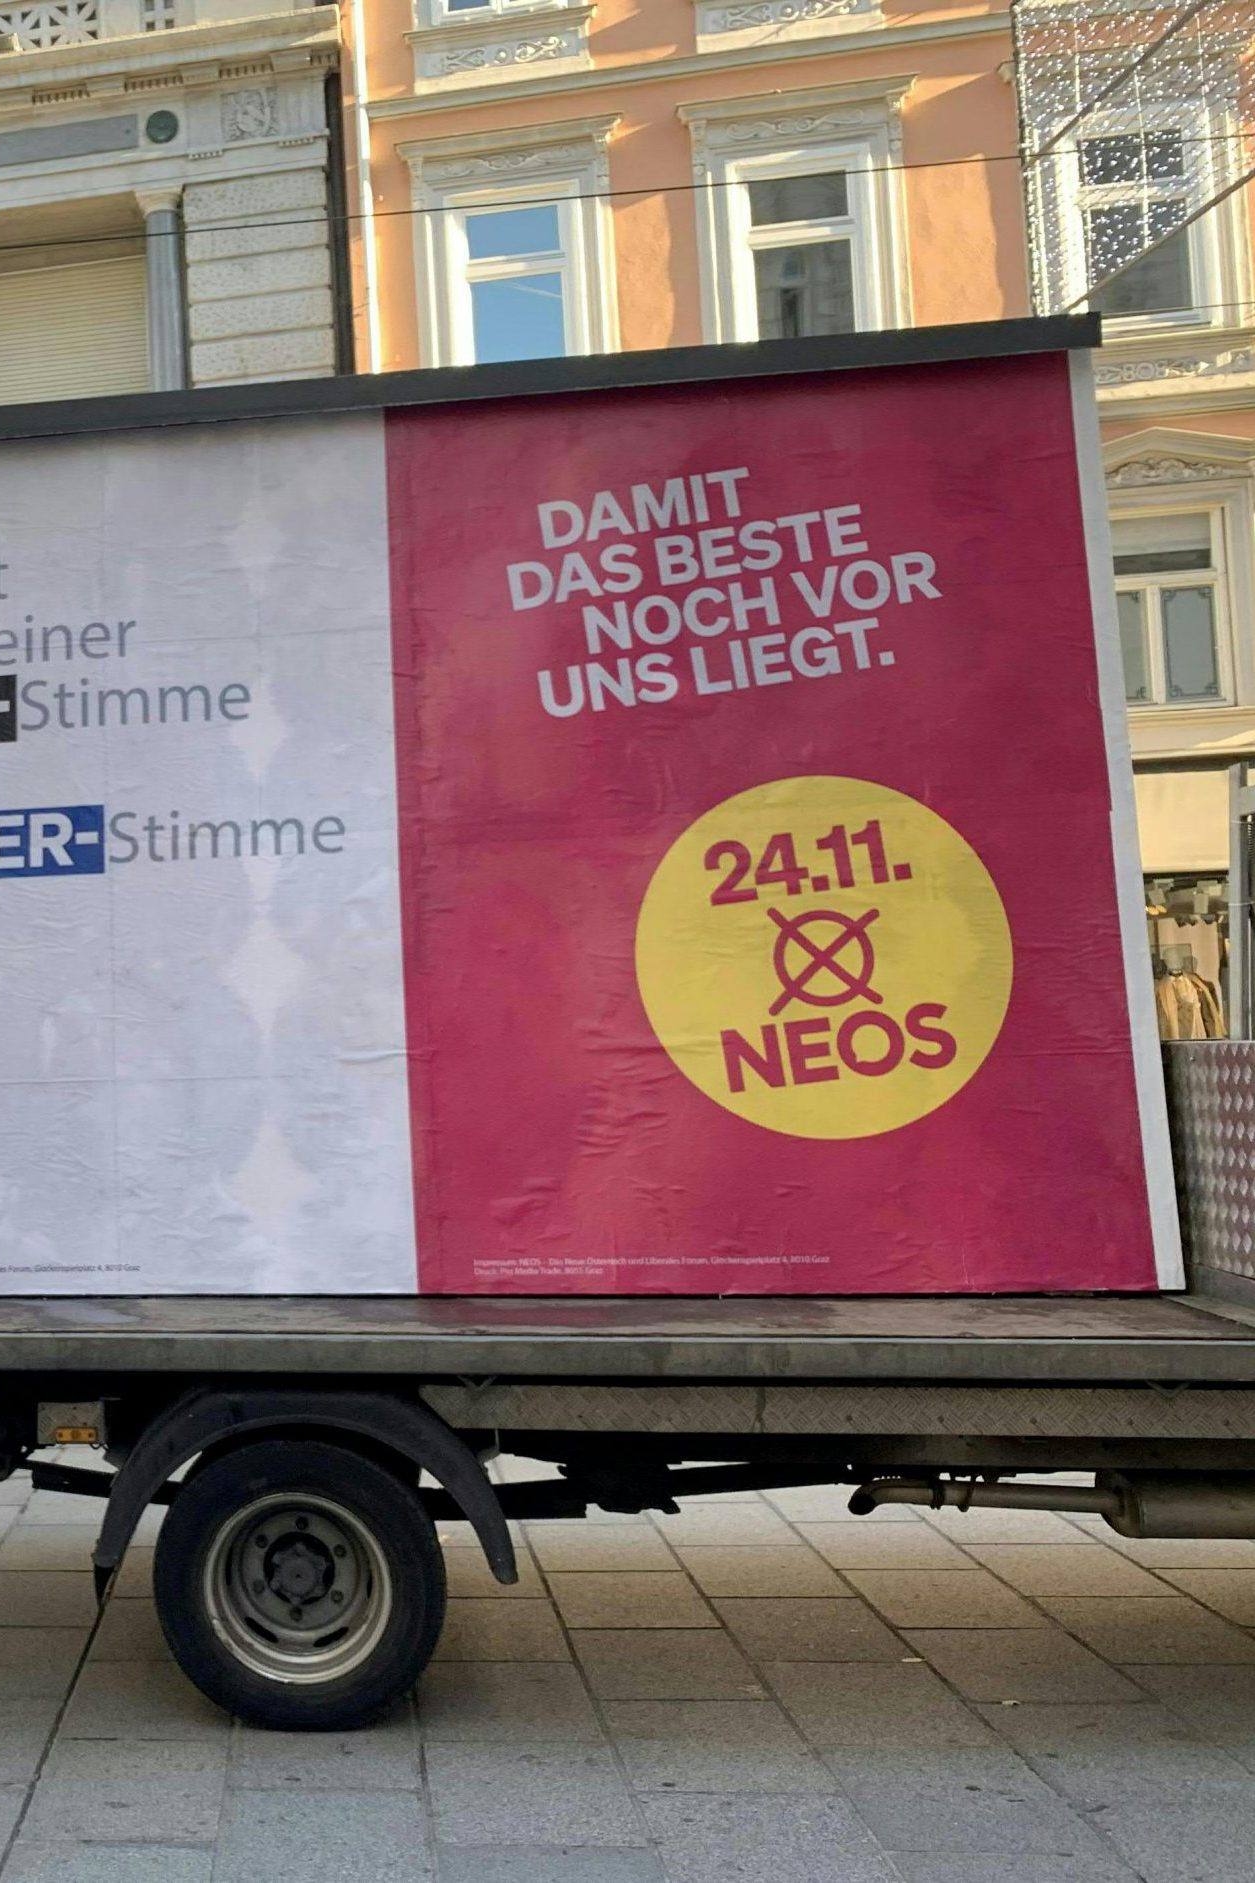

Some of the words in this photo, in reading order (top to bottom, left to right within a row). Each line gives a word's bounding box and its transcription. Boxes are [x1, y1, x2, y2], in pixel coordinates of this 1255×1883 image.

[537, 466, 750, 550] DAMIT
[507, 544, 644, 611] DAS
[654, 503, 869, 586] BESTE
[582, 576, 782, 655] NOCH
[789, 552, 944, 618] VOR
[537, 653, 680, 718] UNS
[690, 617, 896, 696] LIEGT.
[703, 819, 913, 907] 24.11.
[719, 1002, 958, 1094] NEOS
